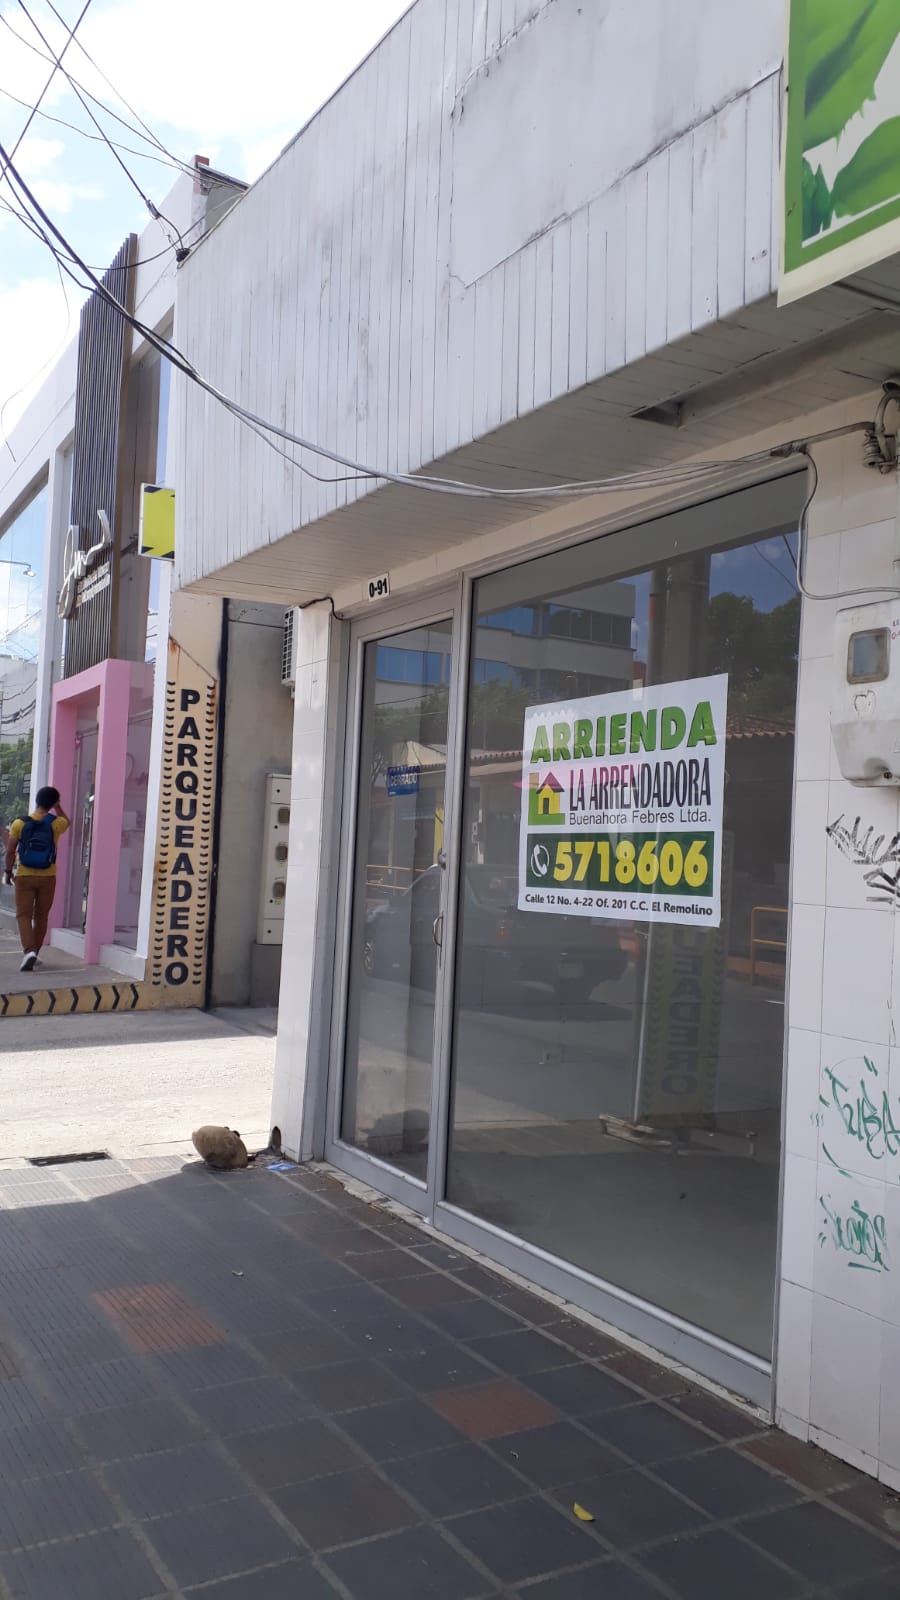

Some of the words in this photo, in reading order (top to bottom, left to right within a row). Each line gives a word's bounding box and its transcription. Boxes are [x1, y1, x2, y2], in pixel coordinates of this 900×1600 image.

[369, 577, 387, 598] 0-91
[530, 701, 717, 764] ARRIENDA
[569, 768, 586, 811] LA
[590, 757, 712, 810] ARRENDADORA
[164, 688, 201, 986] PARQUEADERO
[569, 811, 628, 826] Buenahora
[632, 811, 675, 825] Febres
[680, 809, 712, 823] Ltda.
[553, 840, 709, 888] 5718606
[525, 893, 545, 904] Calle
[546, 895, 555, 905] 12
[557, 896, 572, 906] No.
[573, 897, 593, 907] 4-22
[595, 898, 610, 908] Of.
[611, 899, 627, 910] 201
[630, 901, 649, 911] C.C.
[652, 901, 661, 912] El
[664, 903, 713, 916] Remolino
